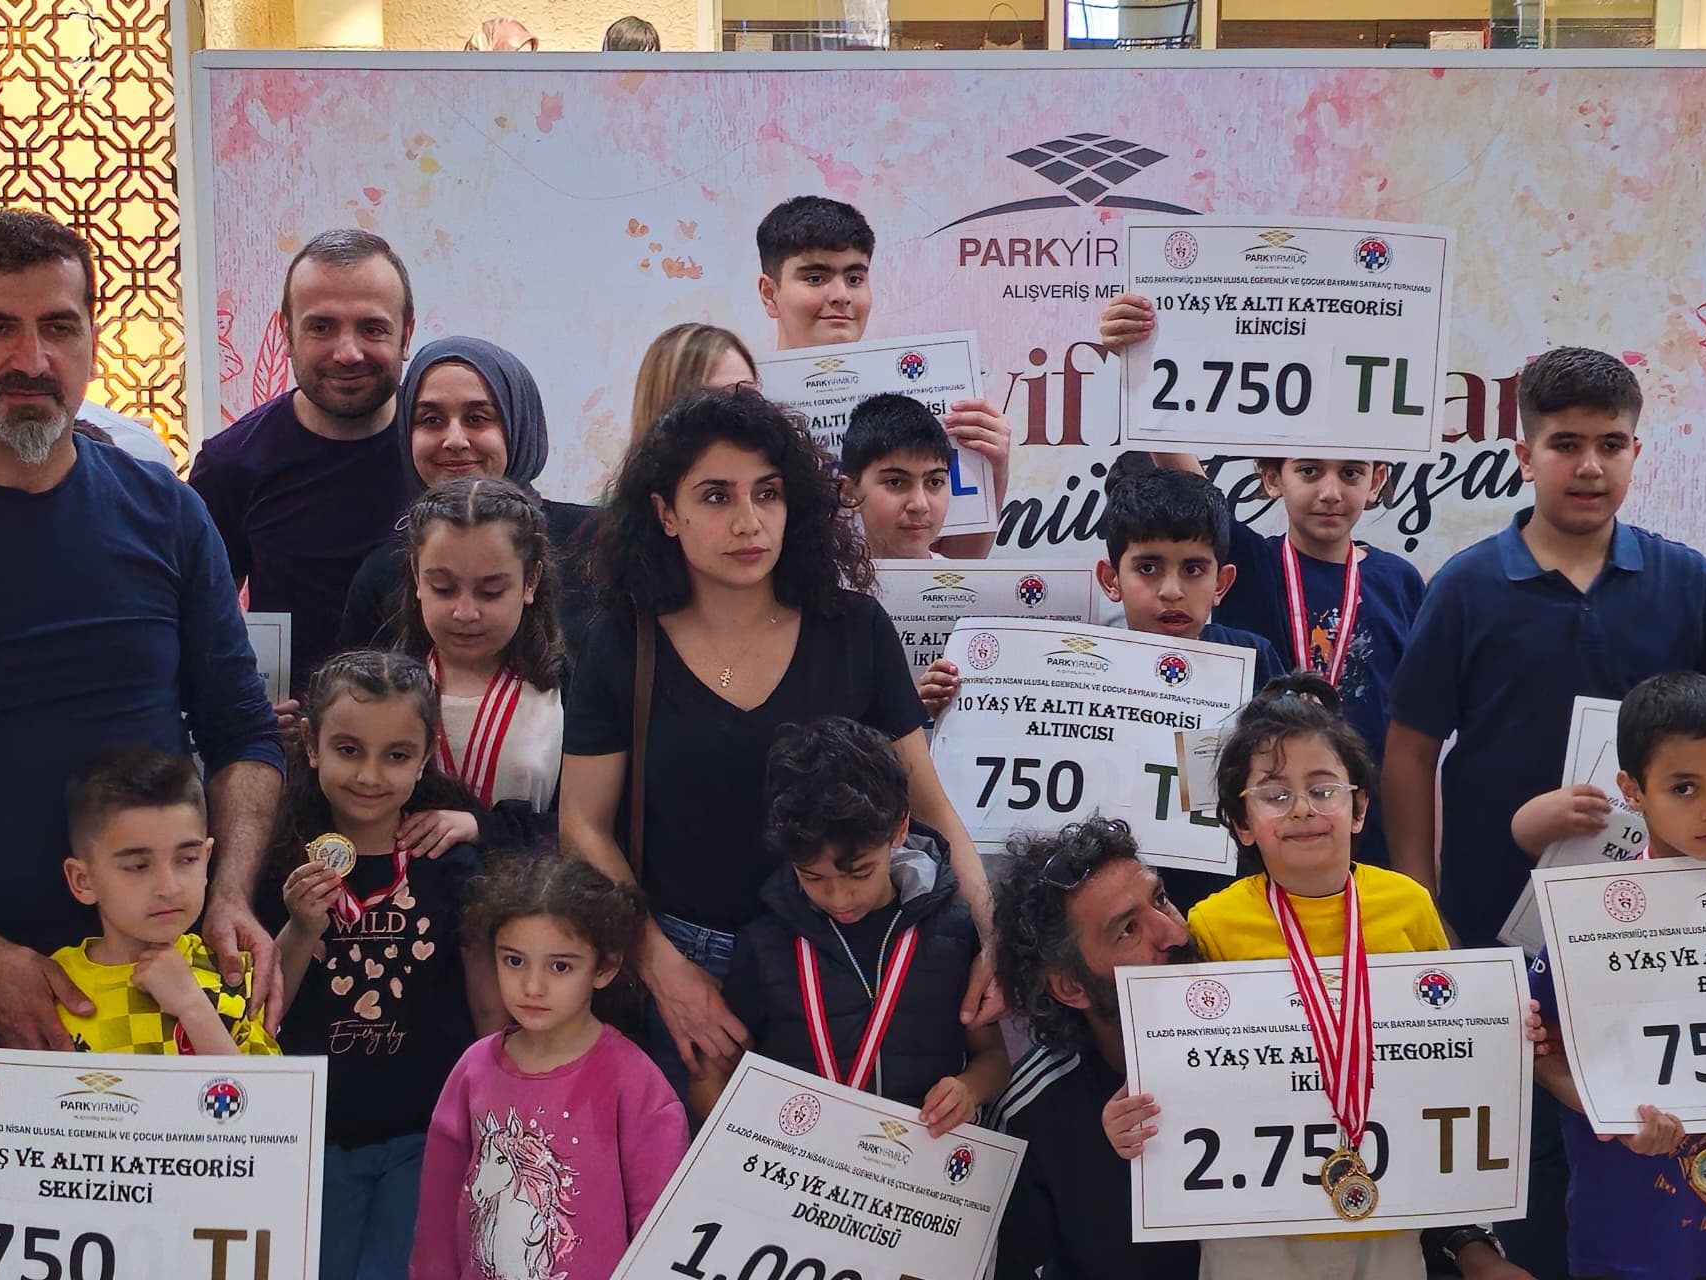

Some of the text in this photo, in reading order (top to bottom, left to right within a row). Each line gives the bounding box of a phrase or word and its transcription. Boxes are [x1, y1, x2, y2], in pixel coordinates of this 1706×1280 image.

[959, 230, 1118, 267] PARKYİR
[1003, 282, 1089, 303] ALIŞVERİŞ
[1156, 293, 1403, 317] 10 YAŞ VE ALTI KATEGORİSİ
[1236, 317, 1306, 335] İKİNCİSİ
[1153, 358, 1312, 415] 2.750
[1346, 355, 1424, 415] TL
[957, 691, 1201, 730] 10 YAŞ VE ALTI KATEGORİSİ
[1025, 721, 1114, 742] ALTINCISI
[975, 756, 1084, 813] 750
[1622, 826, 1642, 844] 10
[332, 911, 406, 935] WILD
[1609, 951, 1621, 971] 8
[1624, 950, 1667, 974] YAŞ
[1671, 950, 1697, 967] VE
[1187, 1048, 1200, 1067] 8
[1205, 1046, 1250, 1071] YAŞ
[1254, 1045, 1285, 1065] VE
[6, 1122, 31, 1135] NİSAN
[34, 1126, 65, 1137] ULUSAL
[68, 1126, 117, 1139] EGEMENLİK
[119, 1131, 130, 1140] VE
[133, 1132, 163, 1143] ÇOCUK
[166, 1132, 204, 1142] BAYRAMI
[206, 1133, 247, 1145] SATRANÇ
[249, 1134, 297, 1144] TURNUVASI
[1184, 1106, 1509, 1191] 2.750 TL
[14, 1147, 46, 1168] VE
[52, 1153, 103, 1172] ALTI
[111, 1155, 254, 1177] KATEGORİSİ
[38, 1177, 153, 1204] SEKİZİNCİ
[743, 1153, 963, 1237] 8 YAŞ VE ALTI KATEGORİSİ
[791, 1200, 902, 1249] DÖRDÜNCÜSÜ
